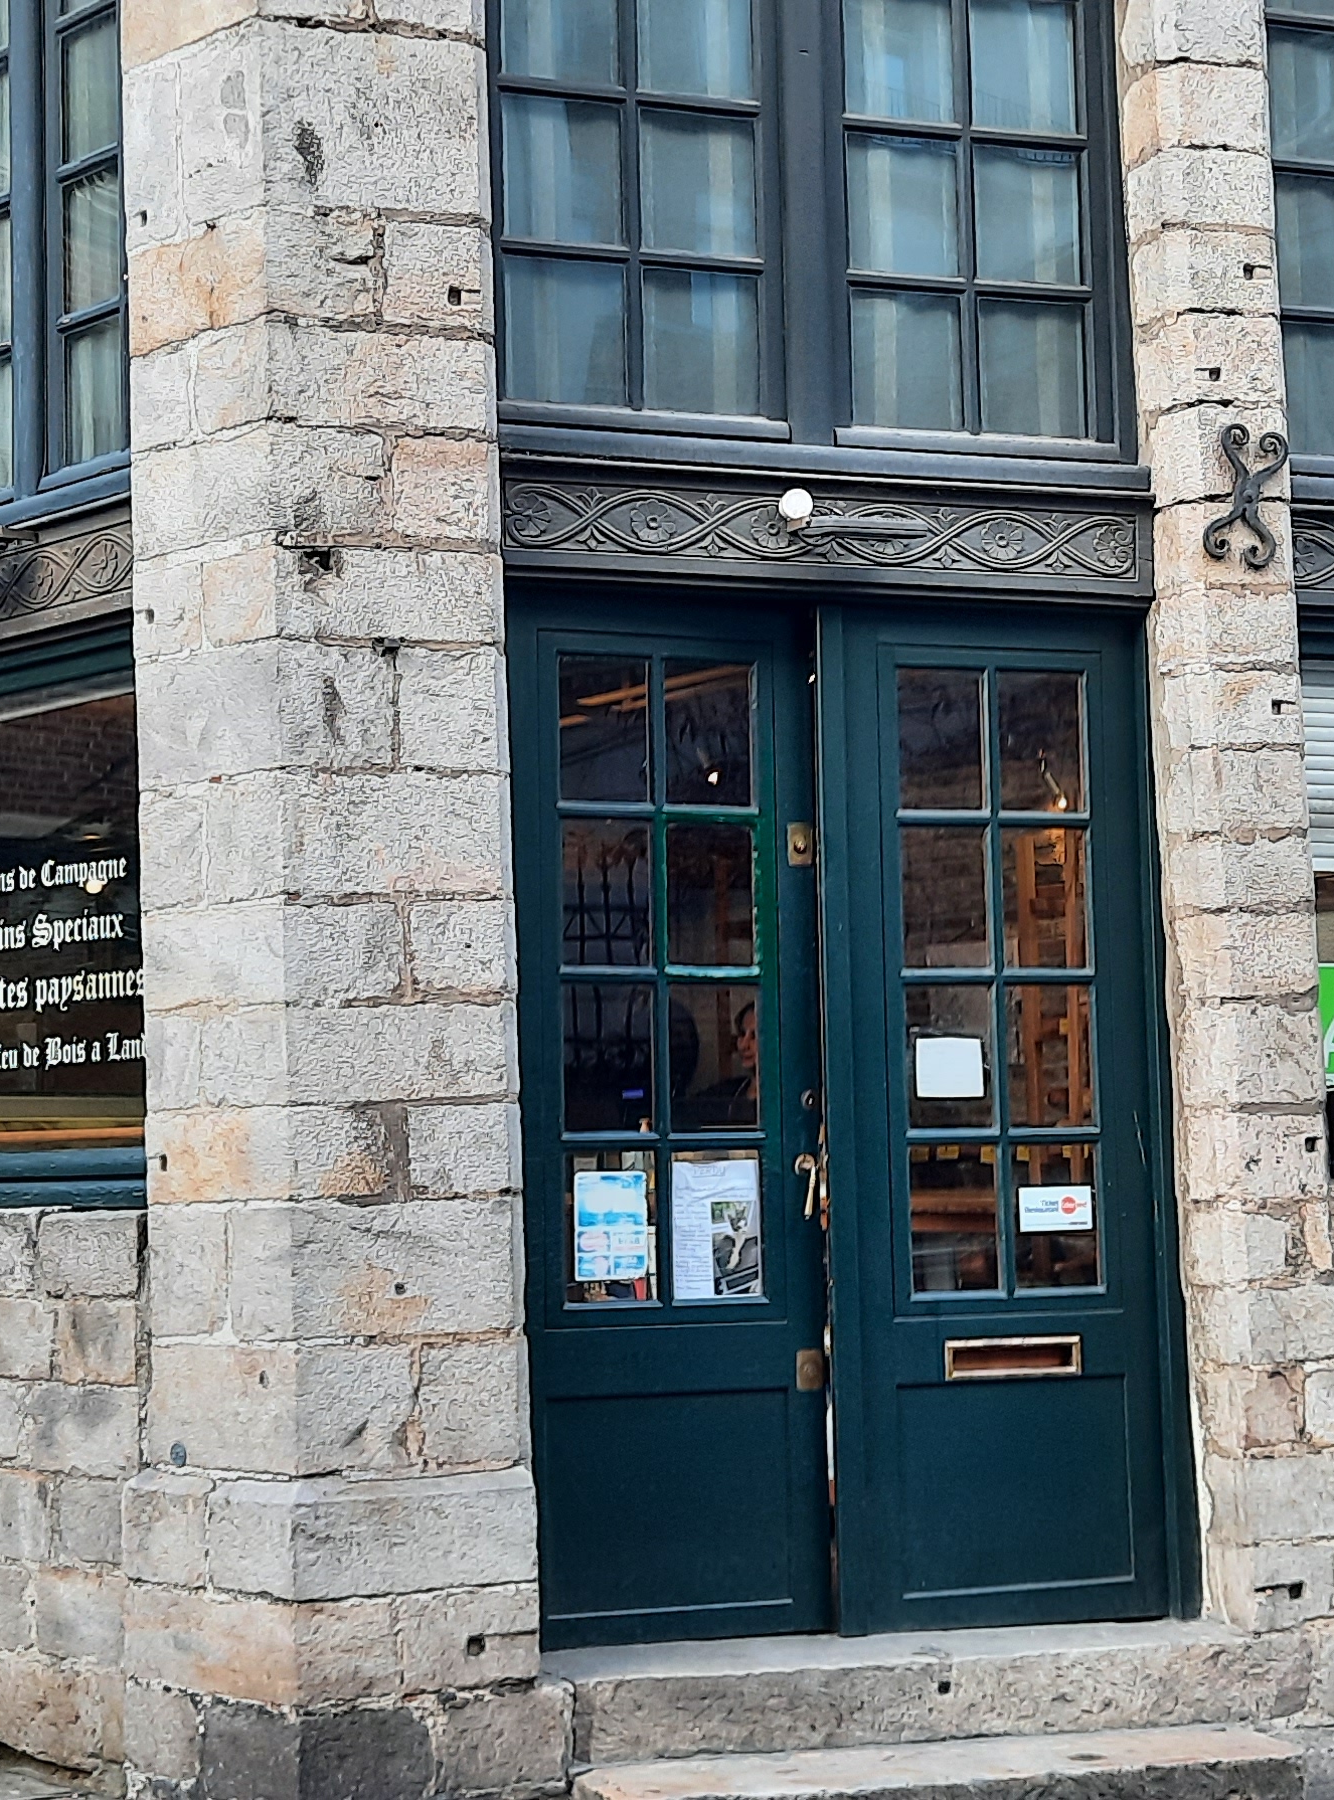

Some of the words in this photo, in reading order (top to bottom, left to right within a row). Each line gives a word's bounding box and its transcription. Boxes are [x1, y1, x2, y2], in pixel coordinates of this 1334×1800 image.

[19, 865, 37, 890] de
[40, 857, 127, 889] Campagne
[31, 908, 124, 951] Speciaux
[35, 968, 145, 1013] paysannes
[23, 1042, 40, 1068] de
[44, 1036, 87, 1071] Bois
[91, 1043, 102, 1063] a
